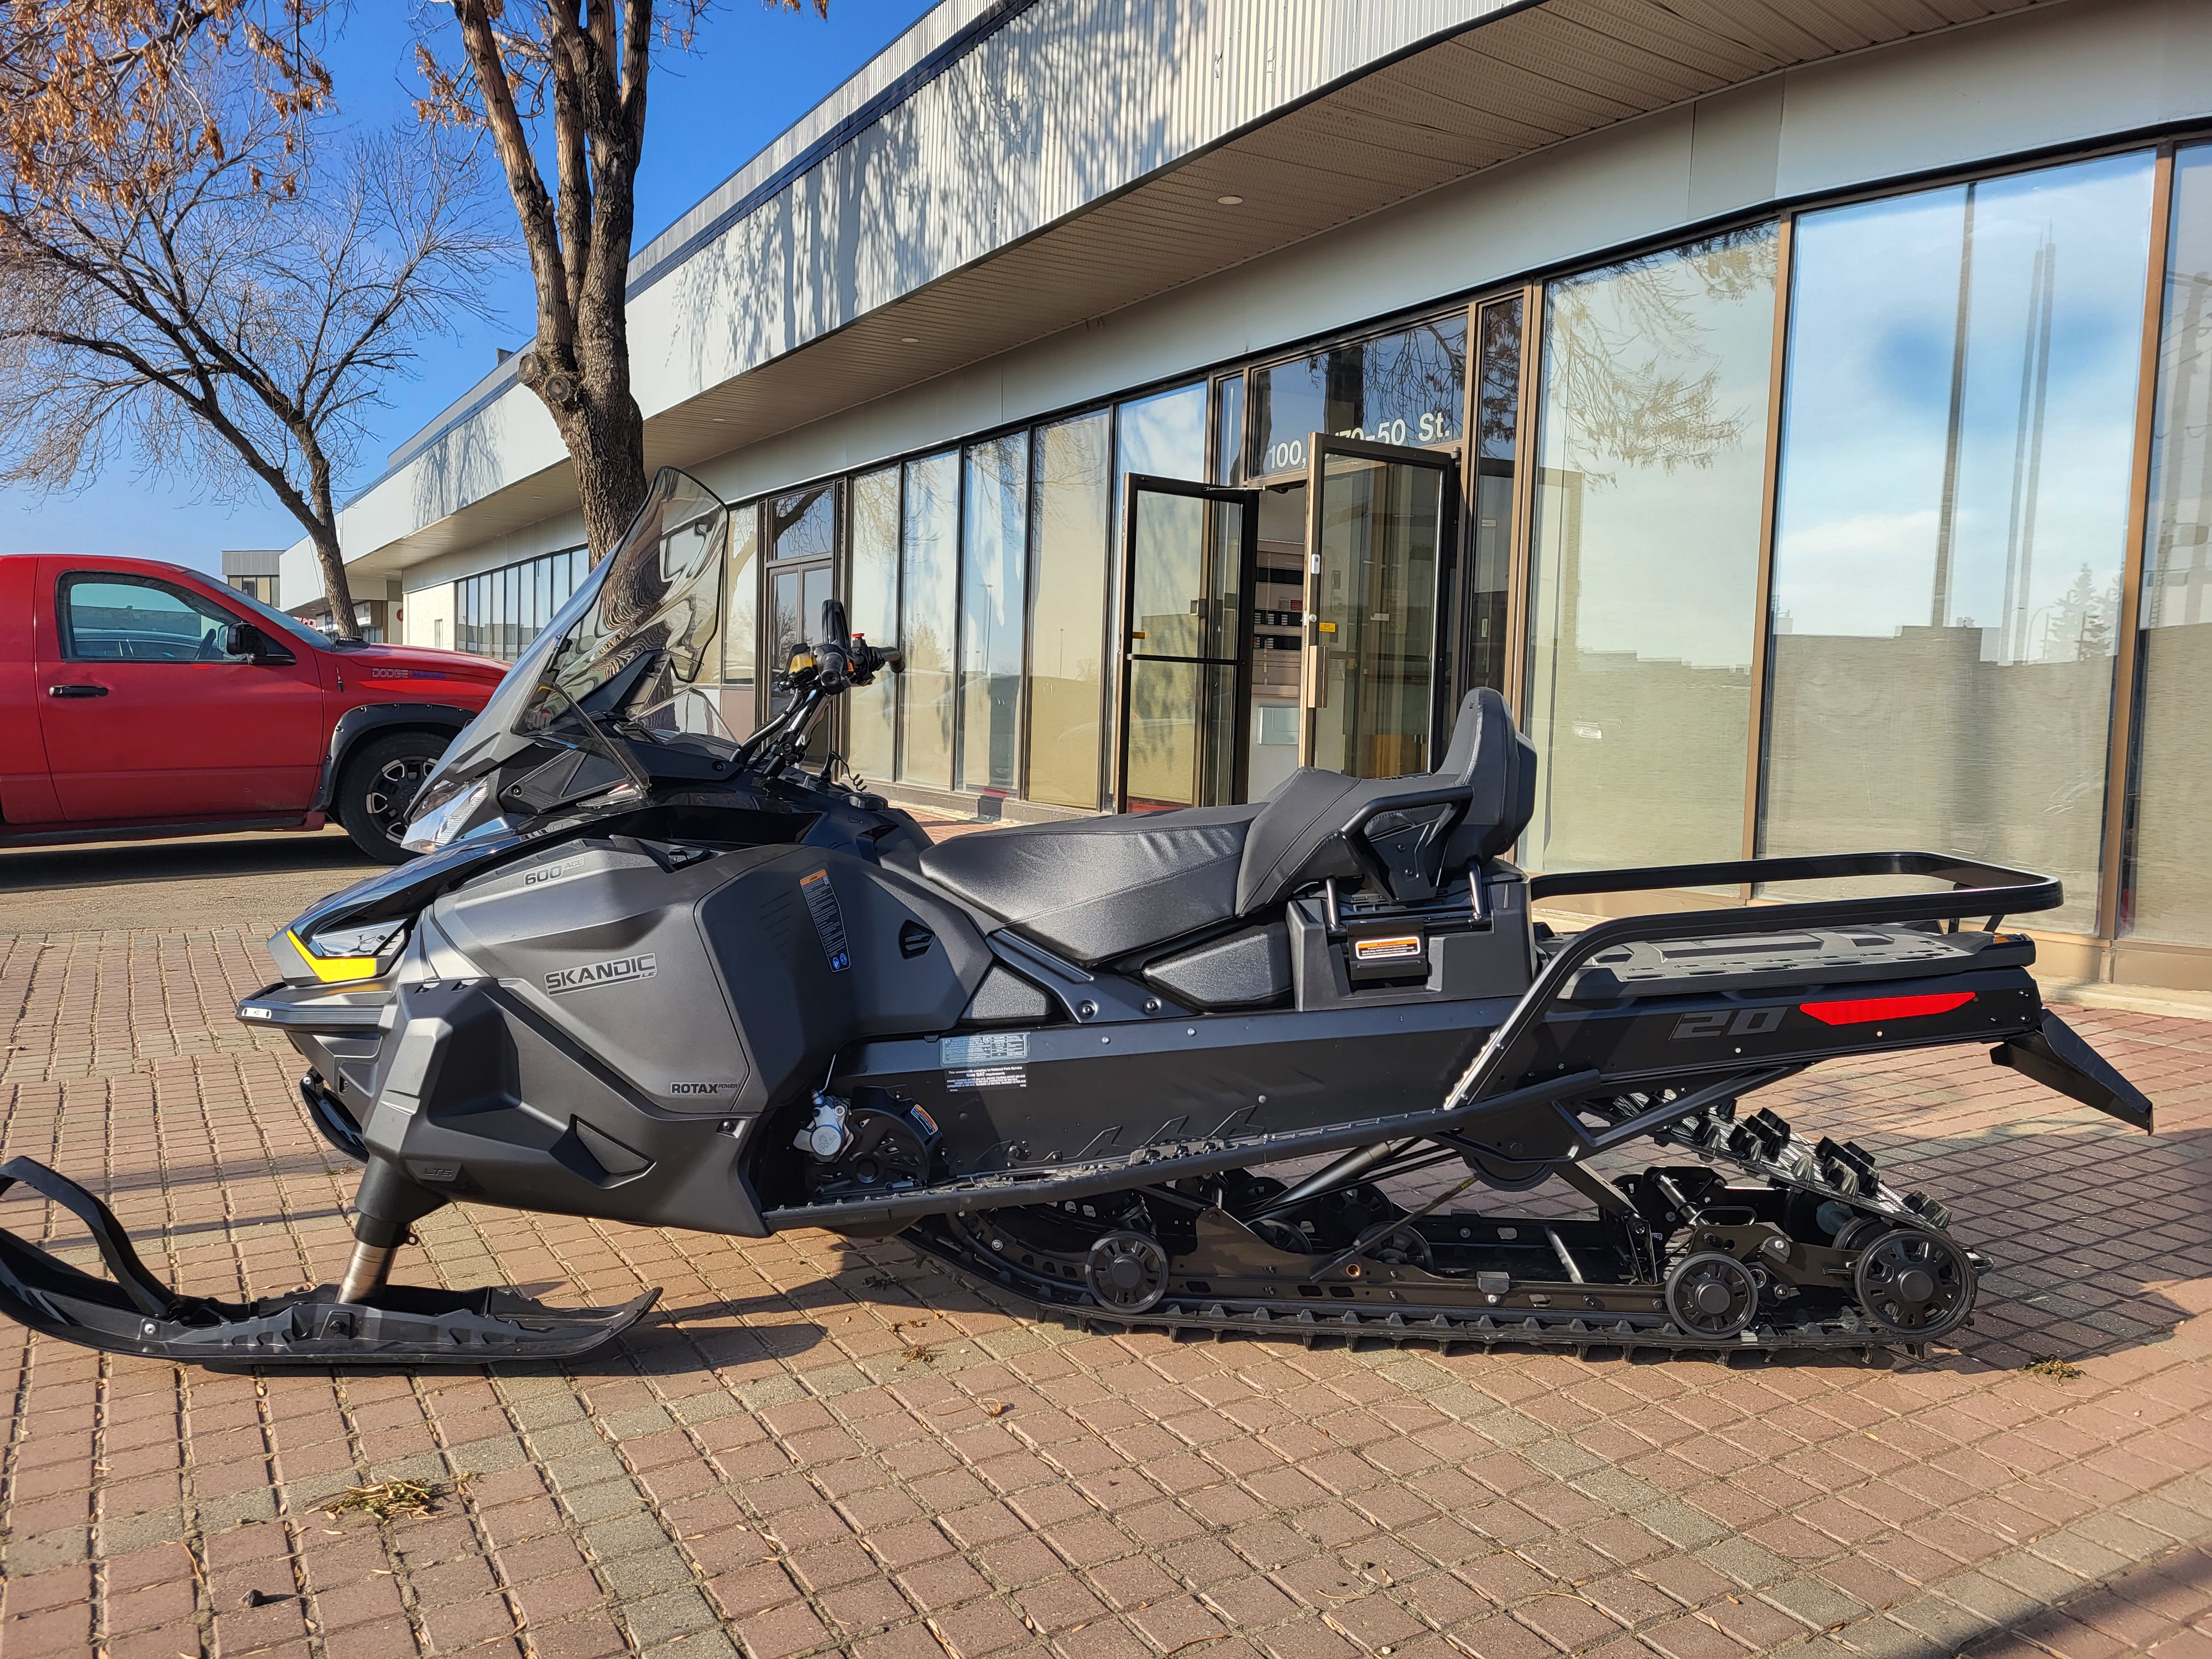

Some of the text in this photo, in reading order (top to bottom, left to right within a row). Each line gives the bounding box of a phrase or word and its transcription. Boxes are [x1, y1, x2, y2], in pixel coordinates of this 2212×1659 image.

[1268, 440, 1306, 469] 100,
[1418, 412, 1450, 442] St.
[372, 668, 409, 678] DODGE
[525, 858, 583, 886] 600 ACE
[545, 954, 655, 989] SKANDIC
[1671, 1006, 1789, 1039] 20
[671, 1083, 718, 1094] ROTAX
[425, 1168, 453, 1177] LTS
